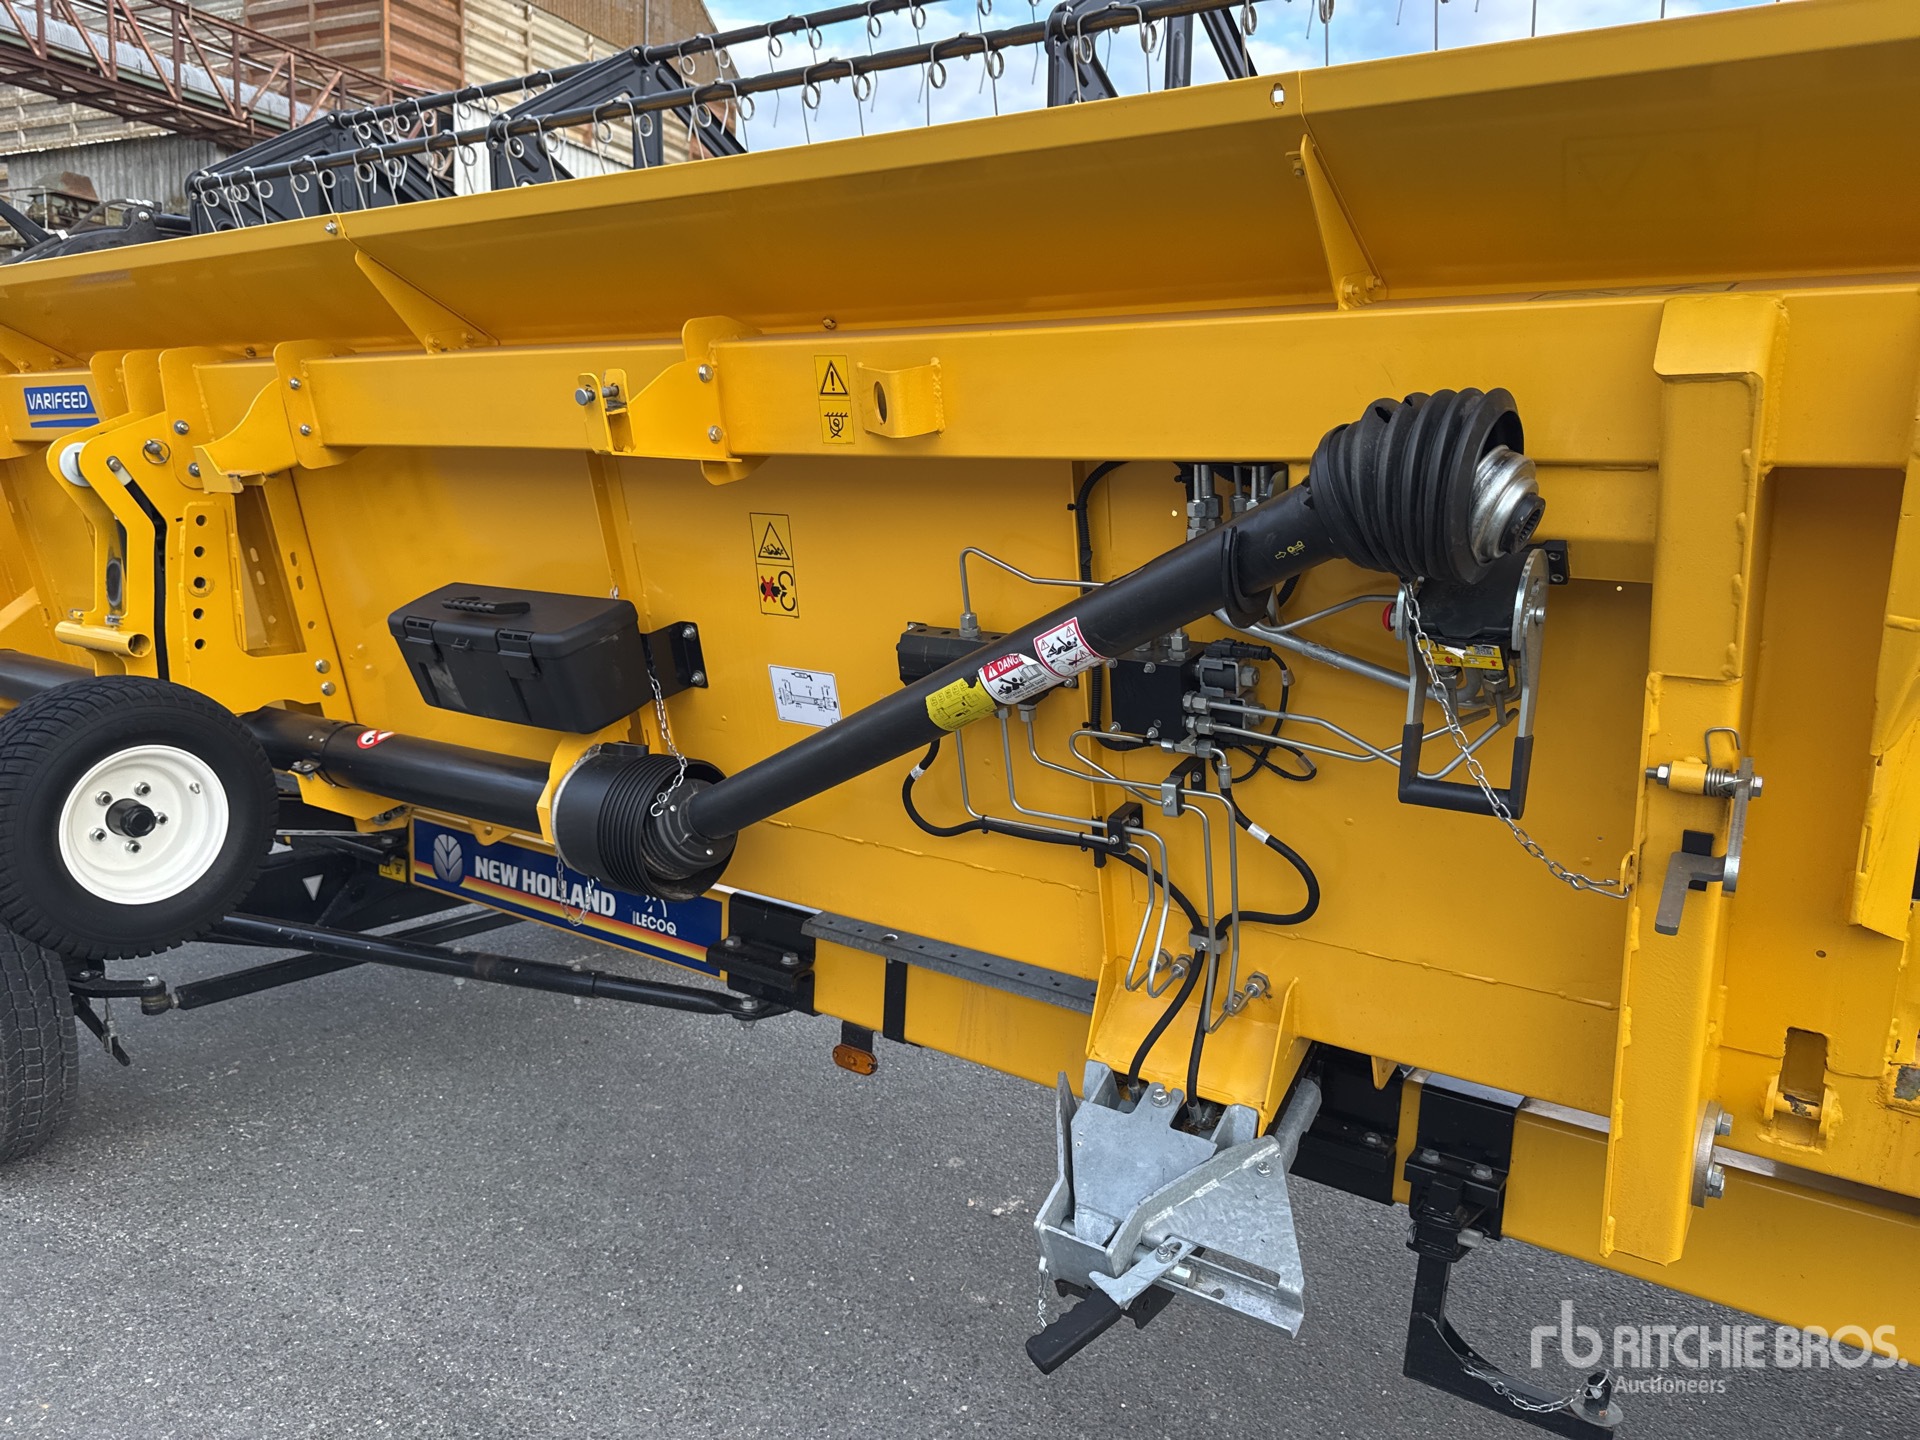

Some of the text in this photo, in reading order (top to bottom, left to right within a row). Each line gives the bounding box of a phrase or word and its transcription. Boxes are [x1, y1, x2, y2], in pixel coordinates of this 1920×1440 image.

[27, 391, 88, 409] VARIFEED
[475, 856, 616, 917] NEW HOLLAND
[635, 912, 677, 936] LECOQ
